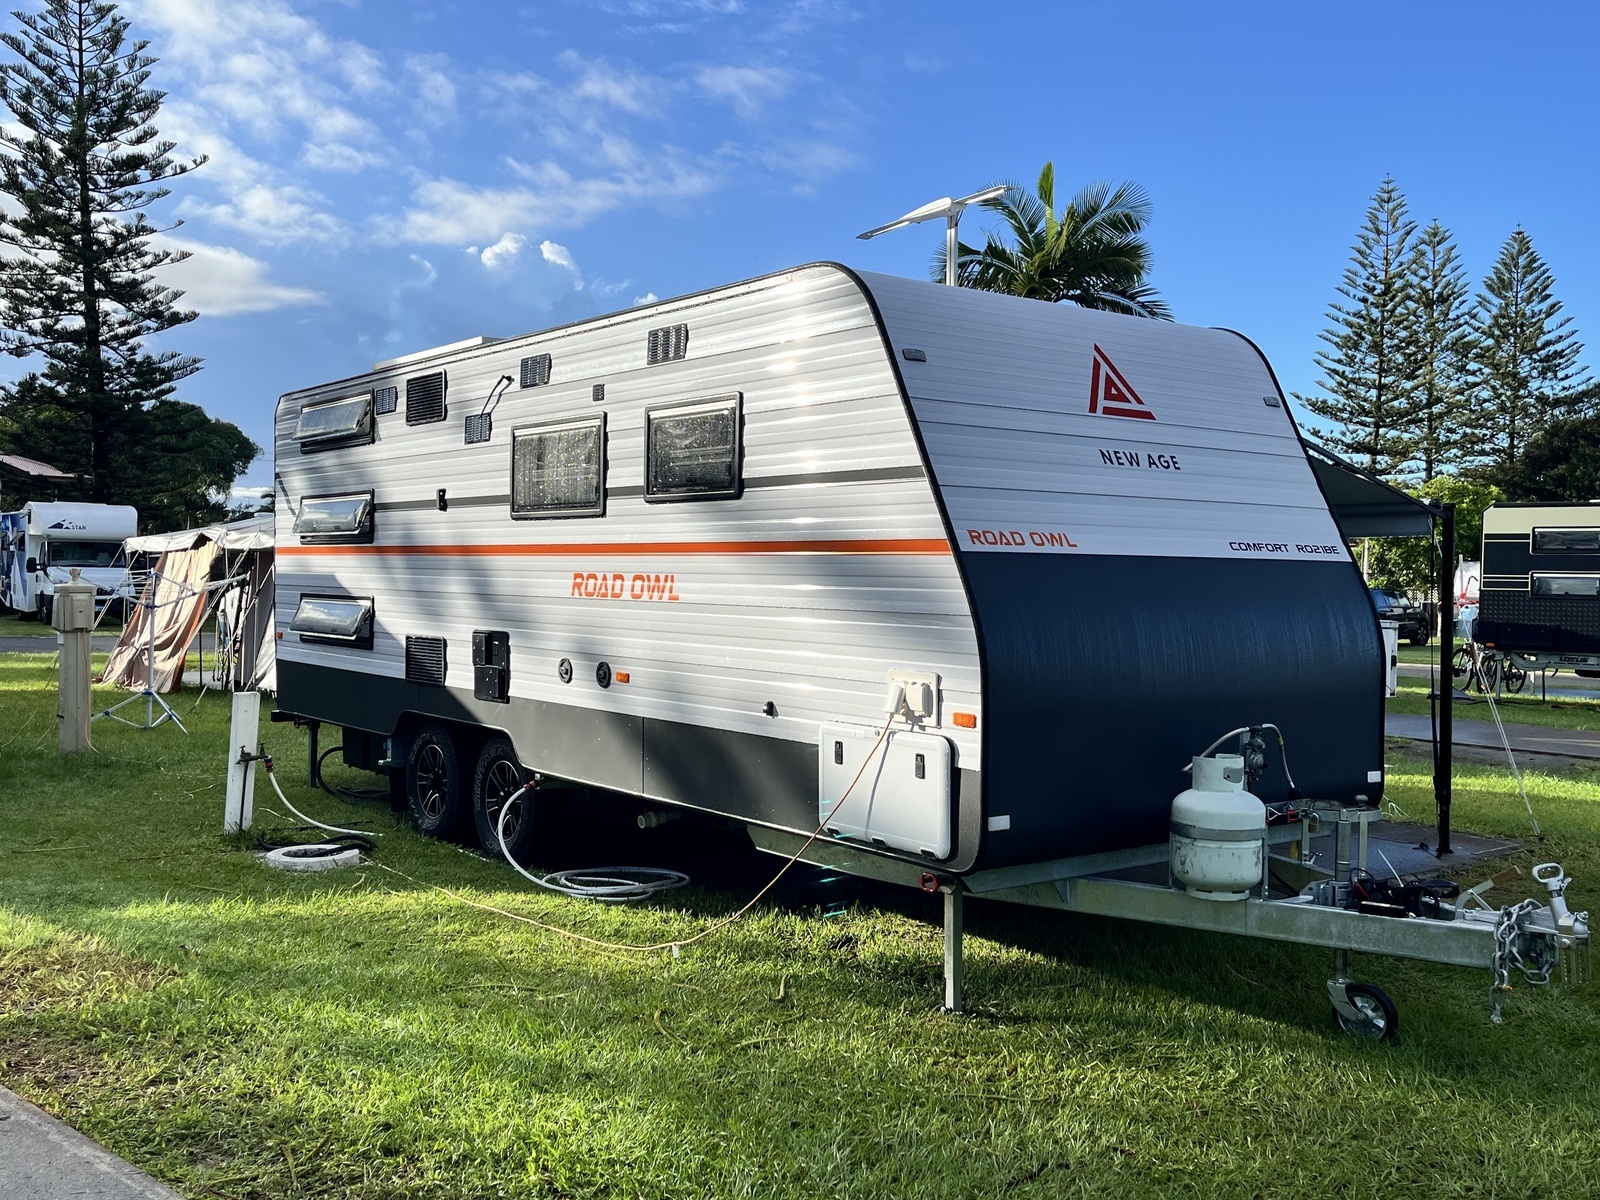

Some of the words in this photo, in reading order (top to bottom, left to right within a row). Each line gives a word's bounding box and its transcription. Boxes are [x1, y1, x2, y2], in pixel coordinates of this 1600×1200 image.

[1098, 449, 1141, 468] NEW
[1147, 453, 1182, 471] AGE
[966, 529, 1026, 546] ROAD
[1029, 531, 1078, 548] OWL
[1229, 541, 1289, 553] COMFORT
[571, 573, 625, 599] ROAD
[630, 574, 680, 601] OWL
